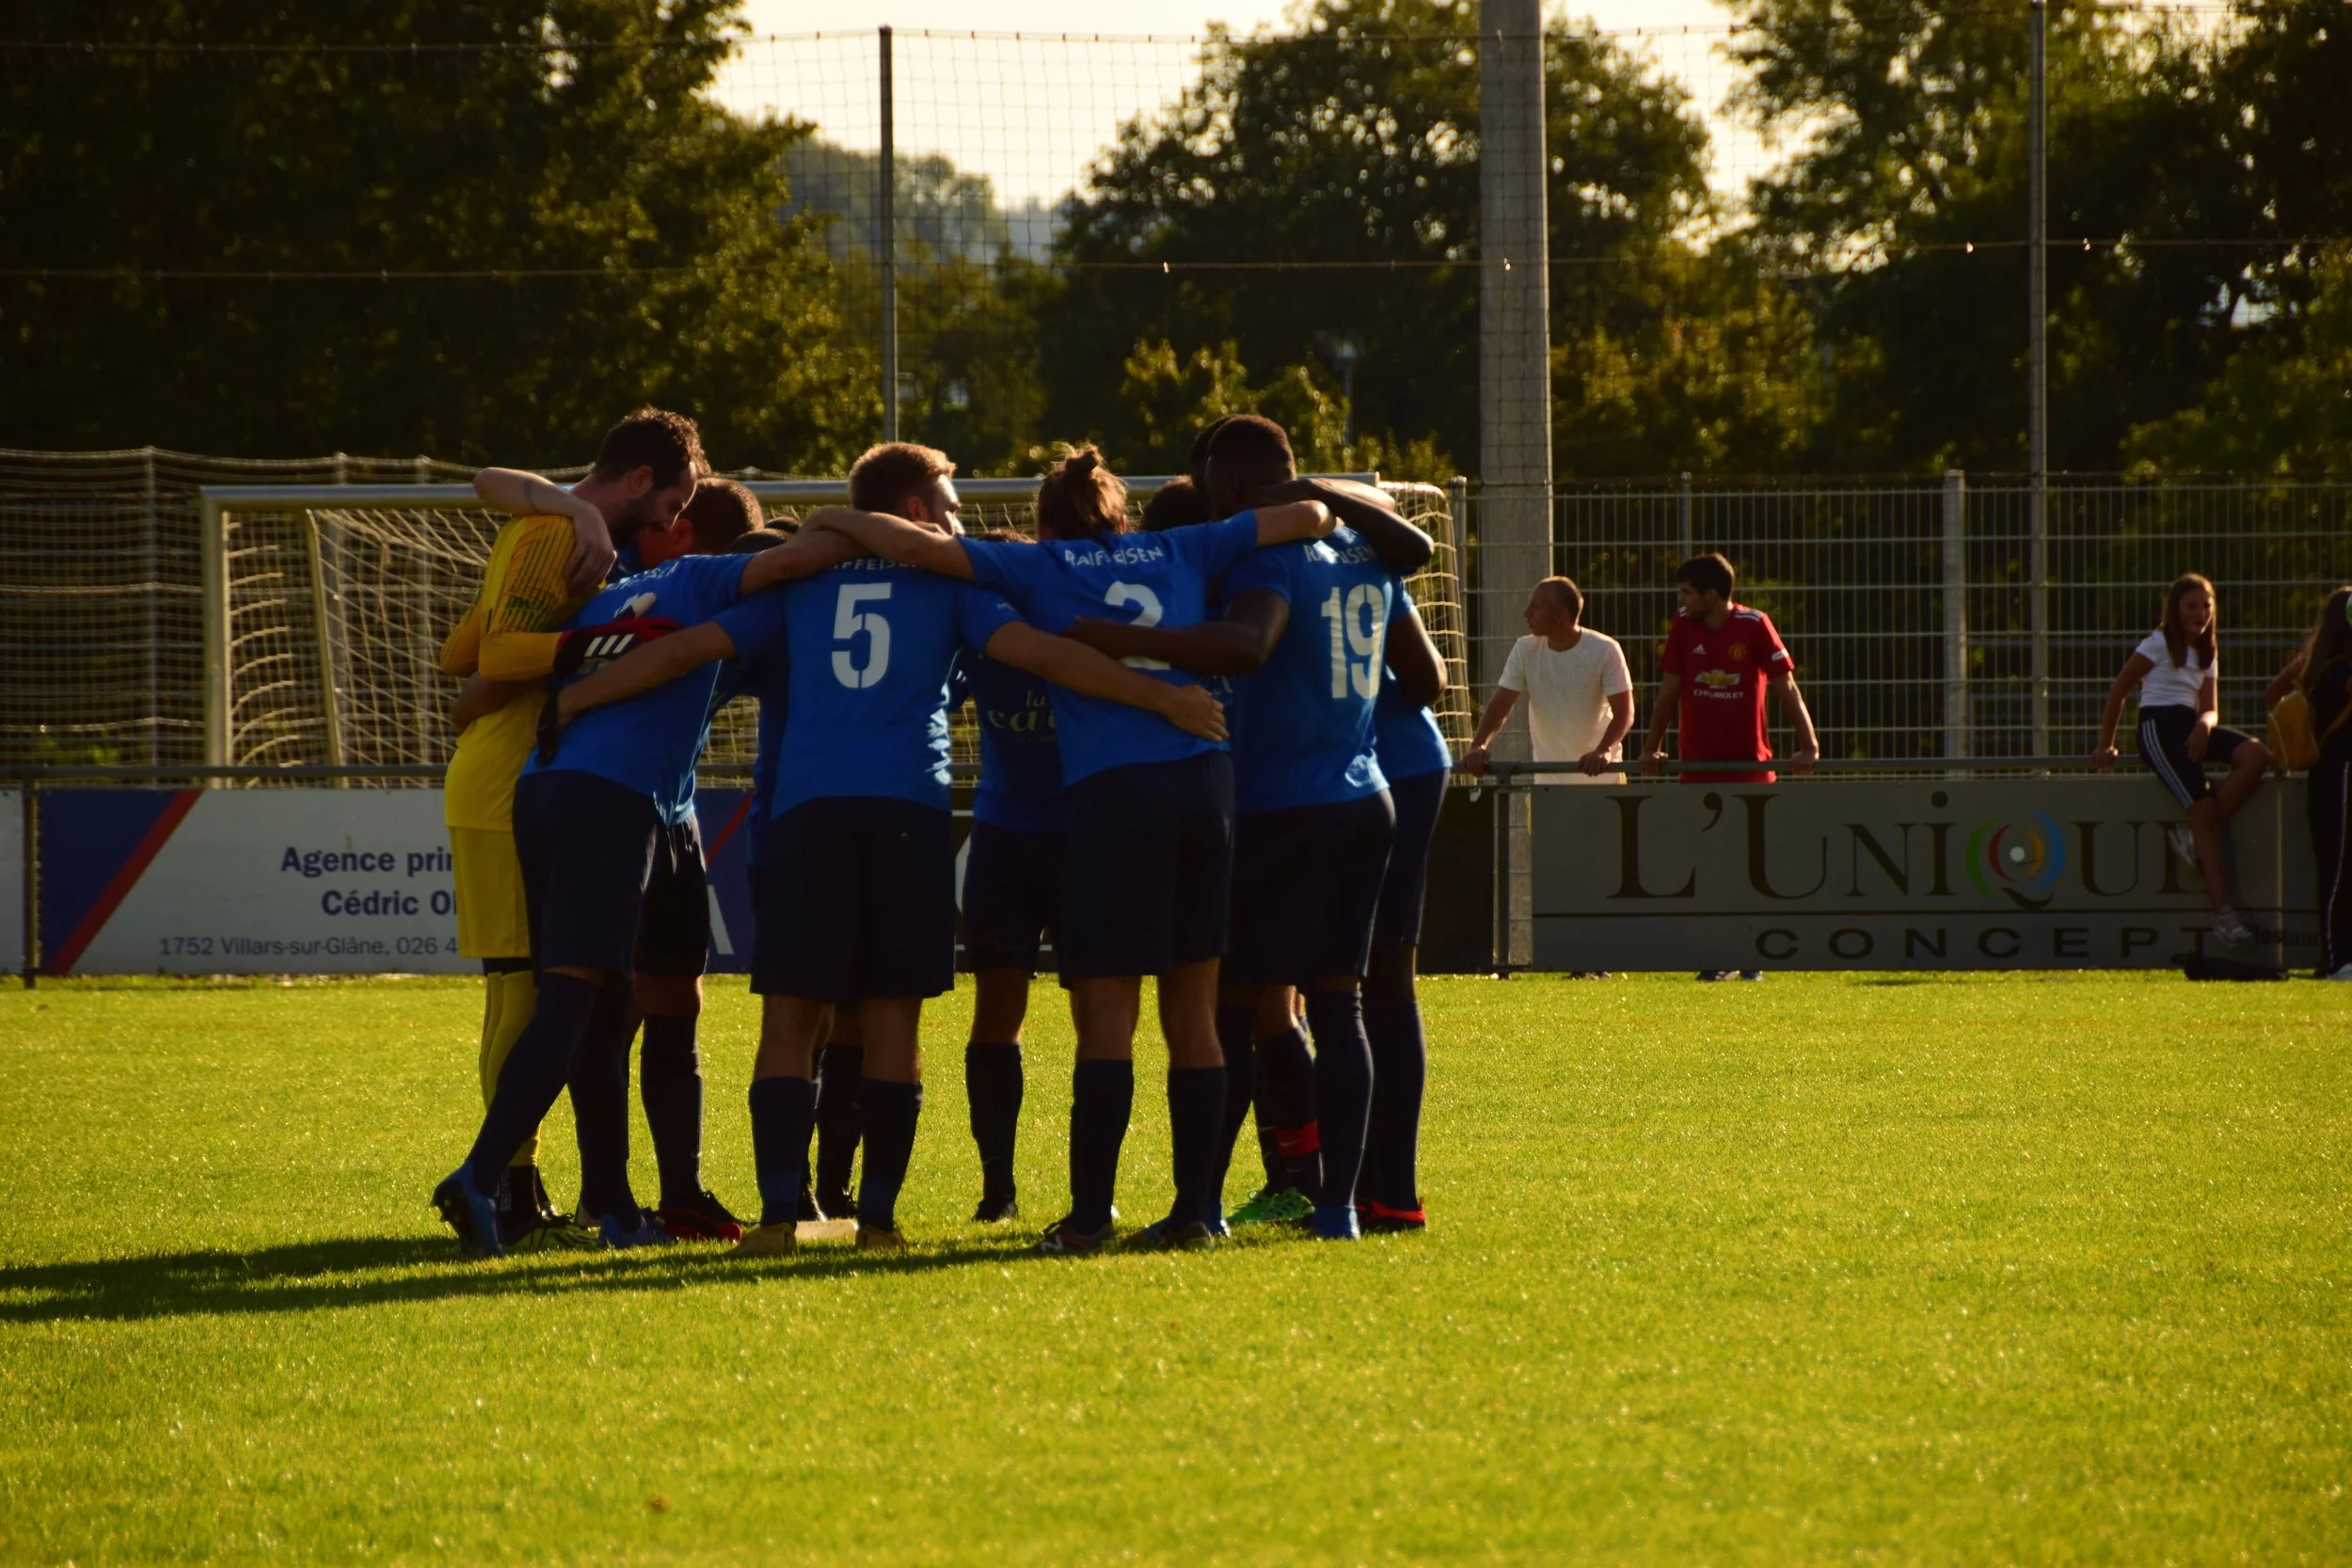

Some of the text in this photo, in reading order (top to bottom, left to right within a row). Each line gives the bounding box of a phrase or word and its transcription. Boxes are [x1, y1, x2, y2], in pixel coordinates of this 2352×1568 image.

[831, 581, 892, 689] 5
[1104, 580, 1171, 671] 2
[1321, 583, 1386, 700] 19
[1692, 689, 1744, 700] CHEVROLET
[280, 846, 396, 879] Agence
[321, 889, 419, 916] Cédric
[159, 937, 215, 956] 1752
[220, 936, 390, 957] Villars-sur-Glâne,
[396, 937, 438, 956] 026
[1756, 926, 2217, 960] CONCEPT
